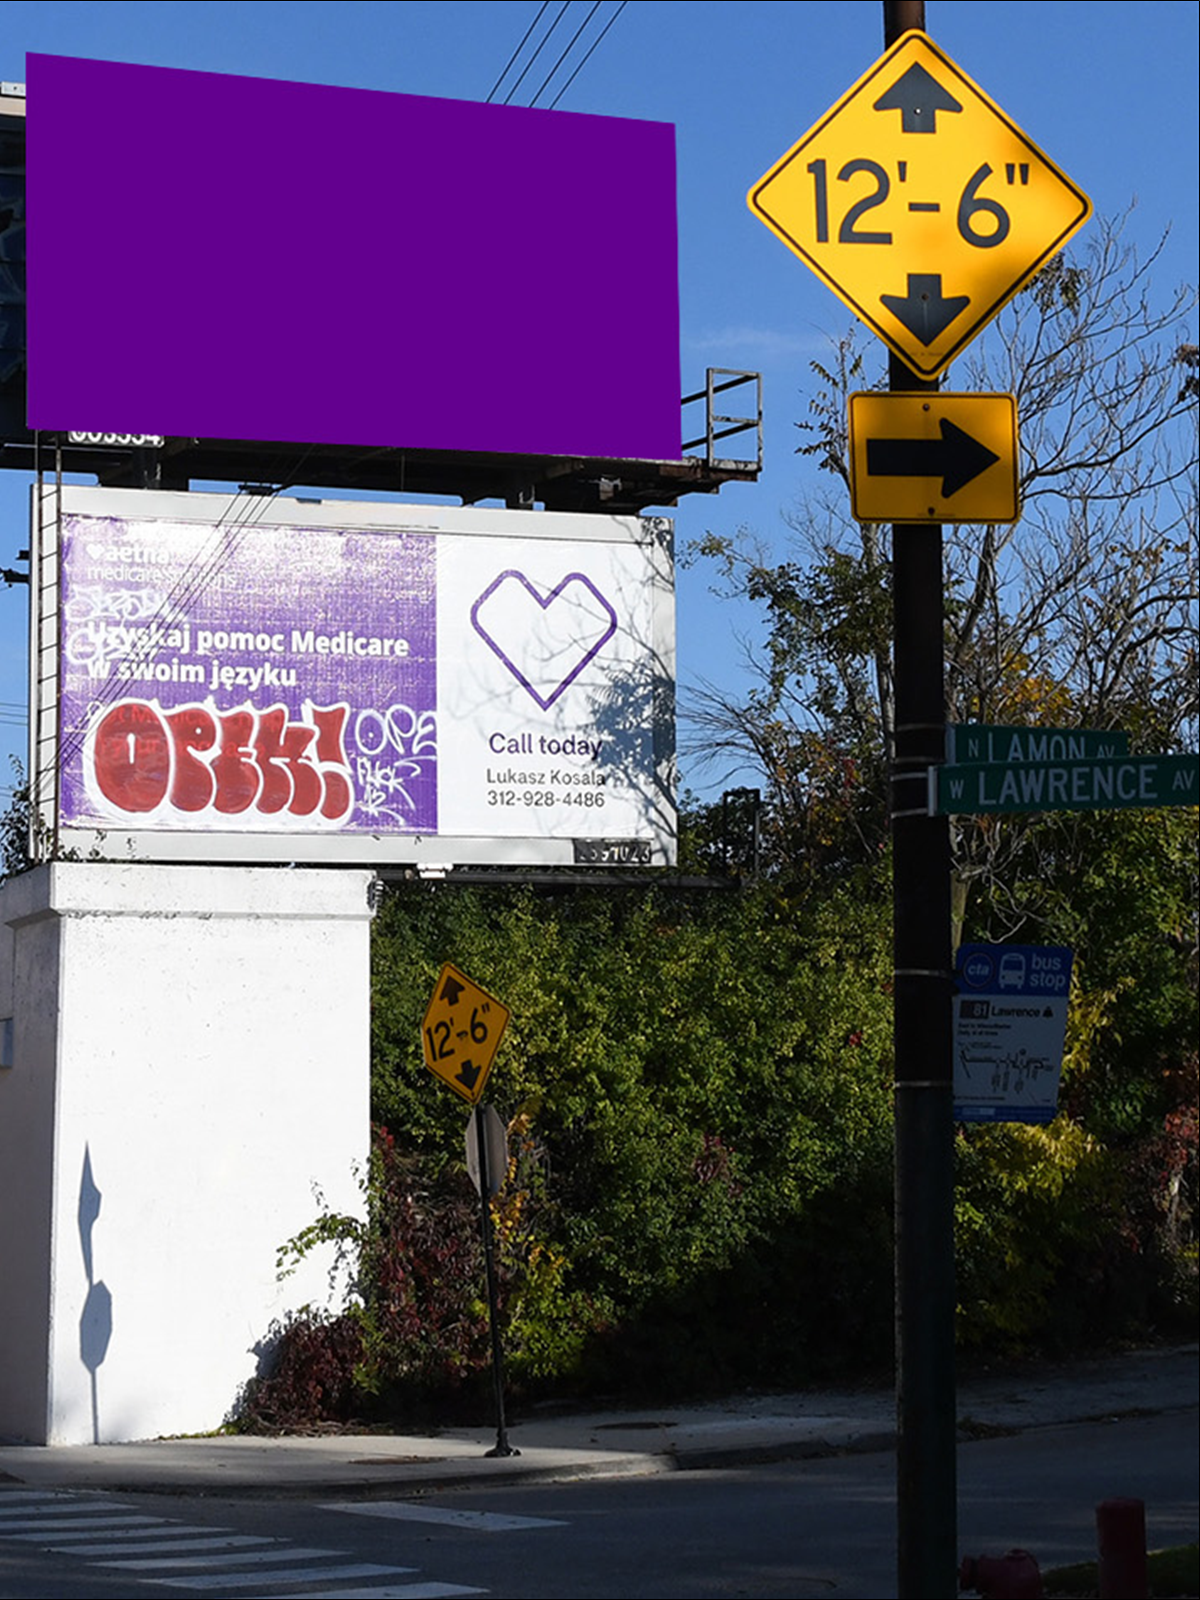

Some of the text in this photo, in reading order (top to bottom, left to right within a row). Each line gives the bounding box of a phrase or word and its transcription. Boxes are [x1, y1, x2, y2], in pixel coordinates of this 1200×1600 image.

[806, 158, 1030, 248] 12'-6"
[106, 543, 170, 564] aetna
[88, 565, 160, 583] medicare
[196, 629, 285, 655] pomoc
[291, 630, 409, 657] Medicare
[117, 657, 205, 684] swoim
[209, 659, 297, 692] języku
[489, 732, 603, 761] Call today
[968, 731, 1115, 763] N LAMON AV
[486, 768, 607, 786] Lukasz Kosala
[950, 764, 1195, 806] W LAWRENCE AV
[487, 790, 606, 808] 312-928-4486
[967, 953, 1062, 976] cta bus
[1029, 971, 1066, 991] stop
[973, 1003, 1041, 1018] 81 Lawrence
[426, 1002, 491, 1062] 12'-6"
